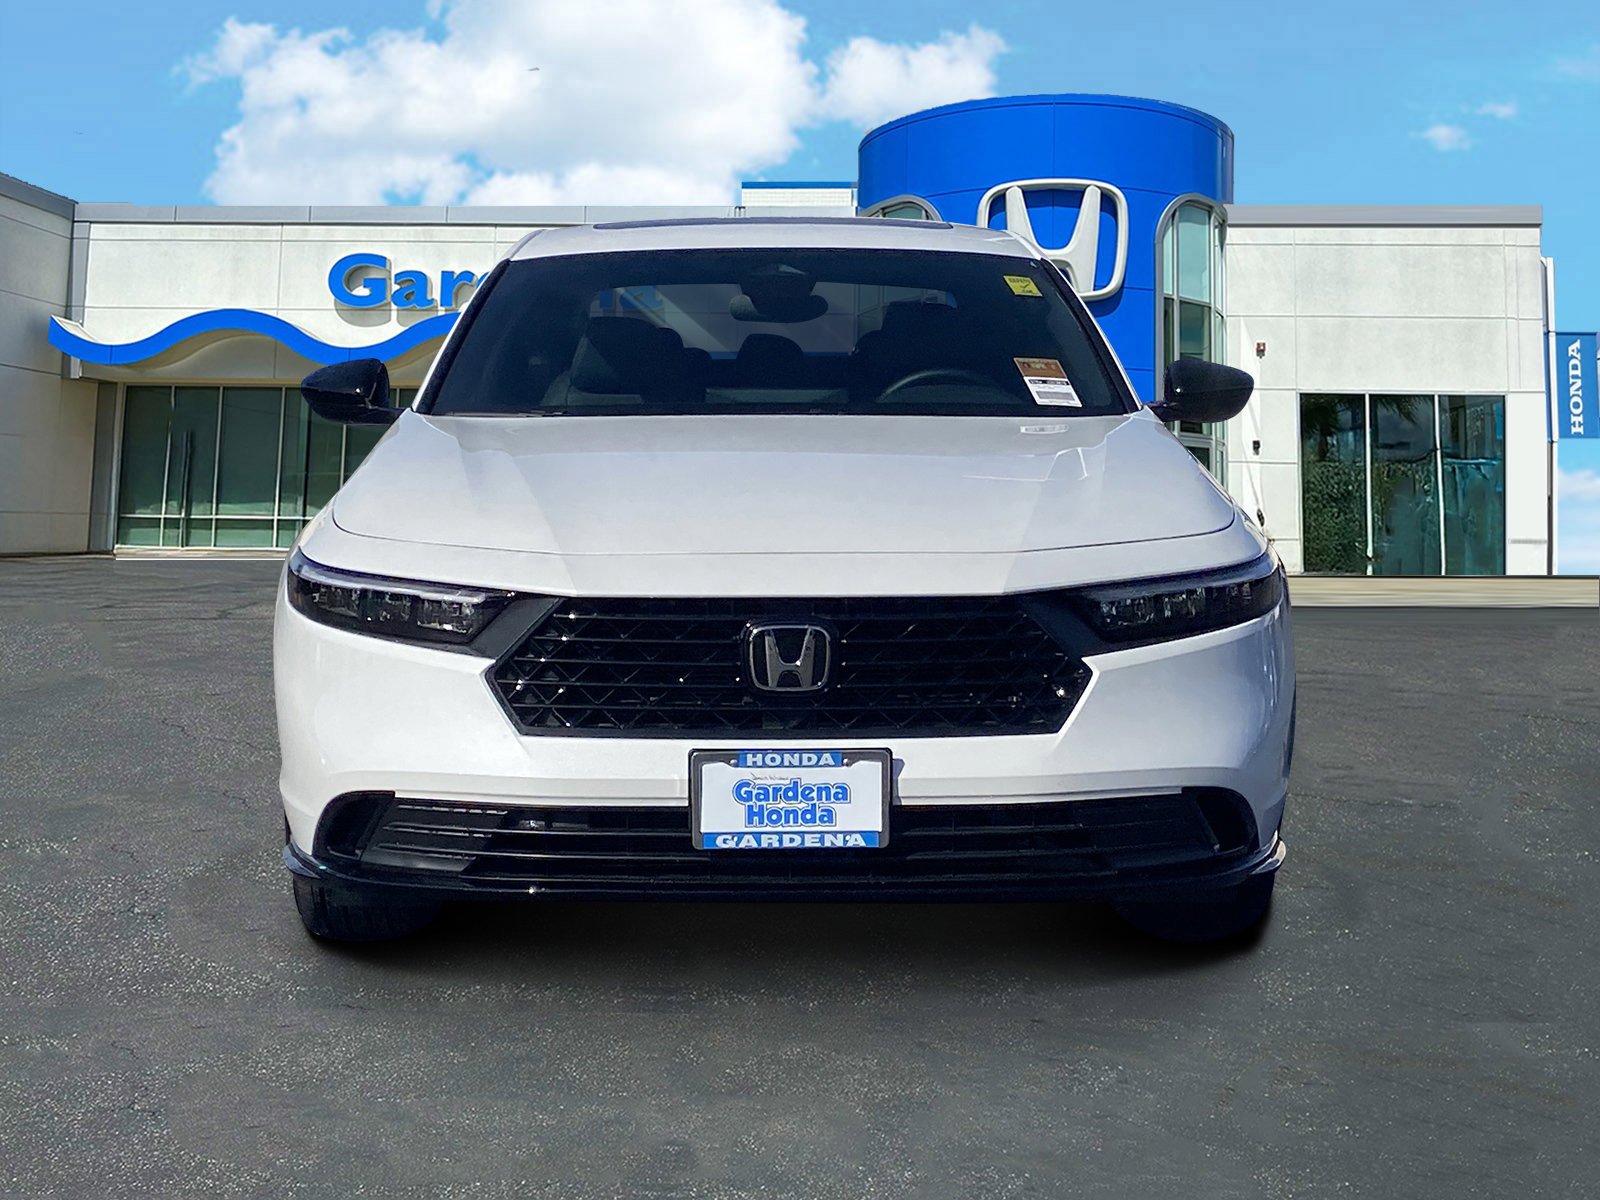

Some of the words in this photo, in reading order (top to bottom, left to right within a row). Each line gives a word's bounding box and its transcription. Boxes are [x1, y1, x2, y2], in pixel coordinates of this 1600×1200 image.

[328, 253, 488, 308] Gar
[1568, 339, 1584, 435] HONDA
[746, 753, 835, 766] HONDA
[733, 779, 850, 804] Gardena
[746, 803, 836, 826] Honda
[716, 833, 866, 848] GARDENA
